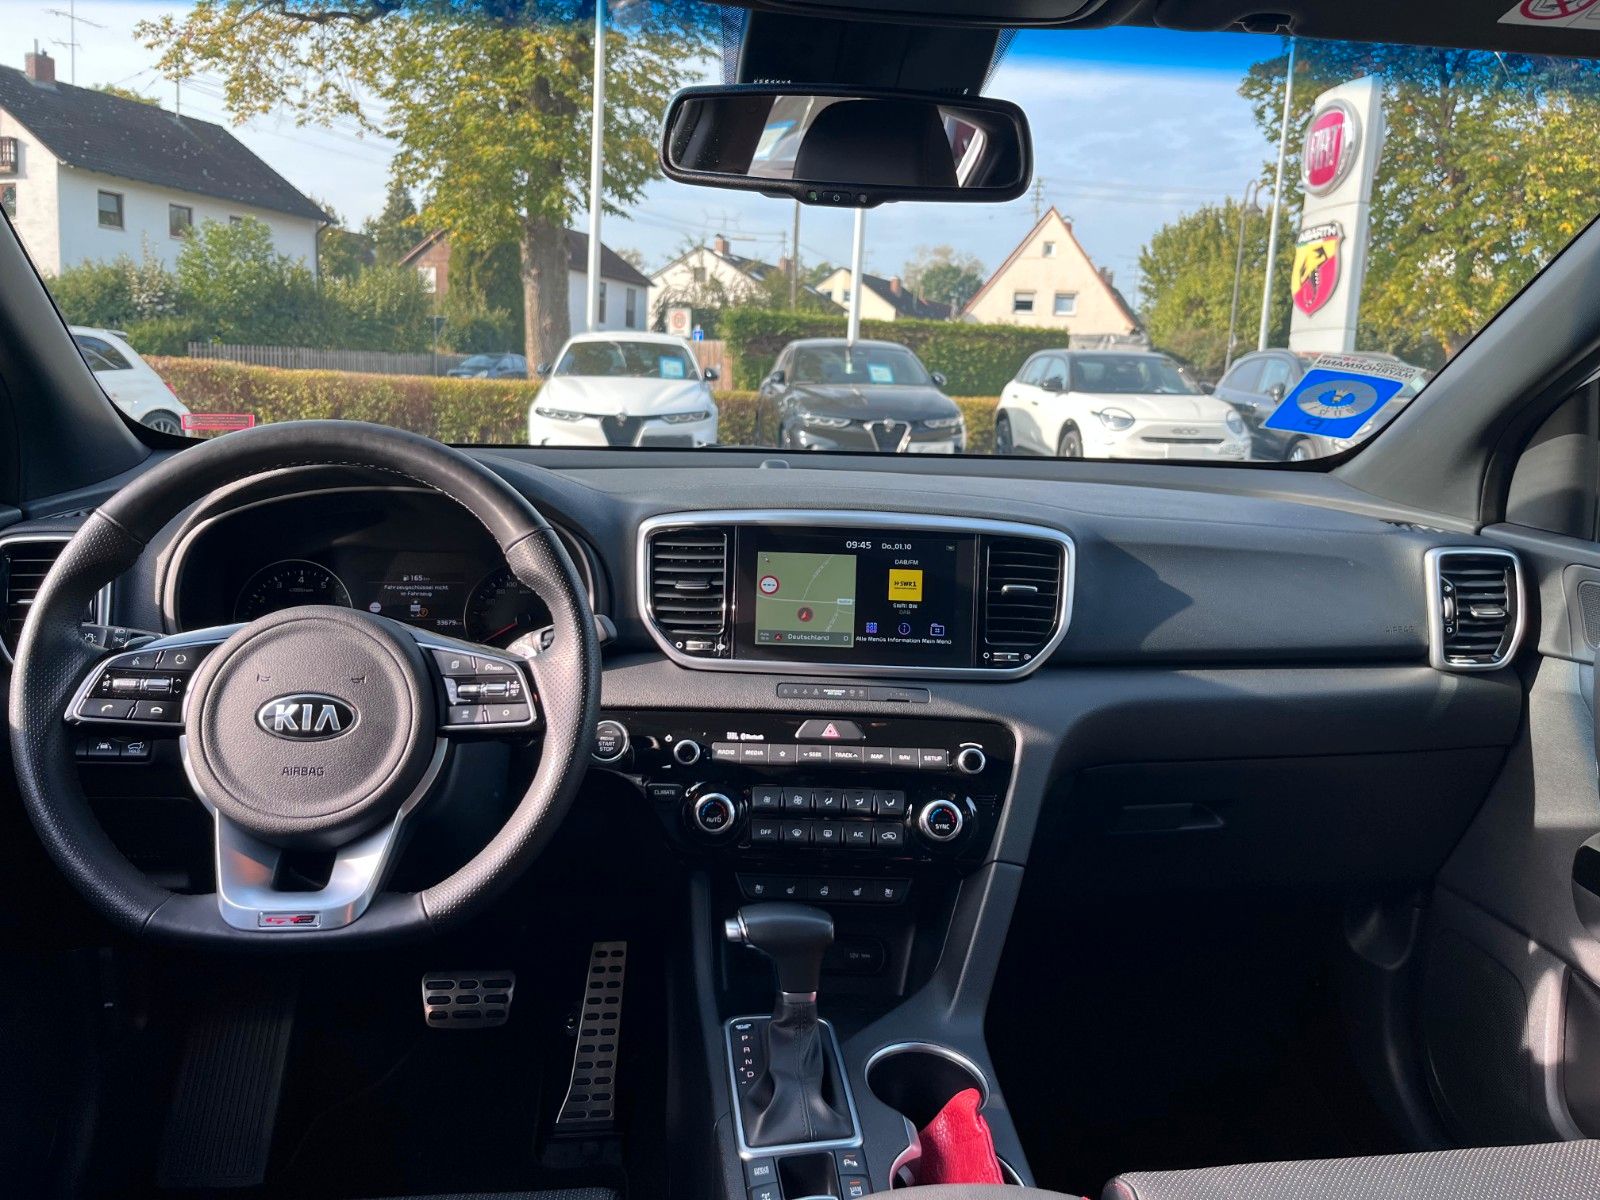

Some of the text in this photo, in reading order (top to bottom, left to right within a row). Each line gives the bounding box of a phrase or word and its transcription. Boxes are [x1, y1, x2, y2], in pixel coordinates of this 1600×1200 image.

[1305, 124, 1341, 171] FIAT
[1297, 224, 1337, 244] ABARTH
[846, 540, 872, 549] 09:45
[894, 558, 919, 566] DAB/FM
[297, 576, 305, 584] 4
[276, 581, 283, 589] 3
[787, 633, 830, 641] Deutschland
[274, 703, 341, 731] KIA
[281, 766, 325, 776] AIRBAG
